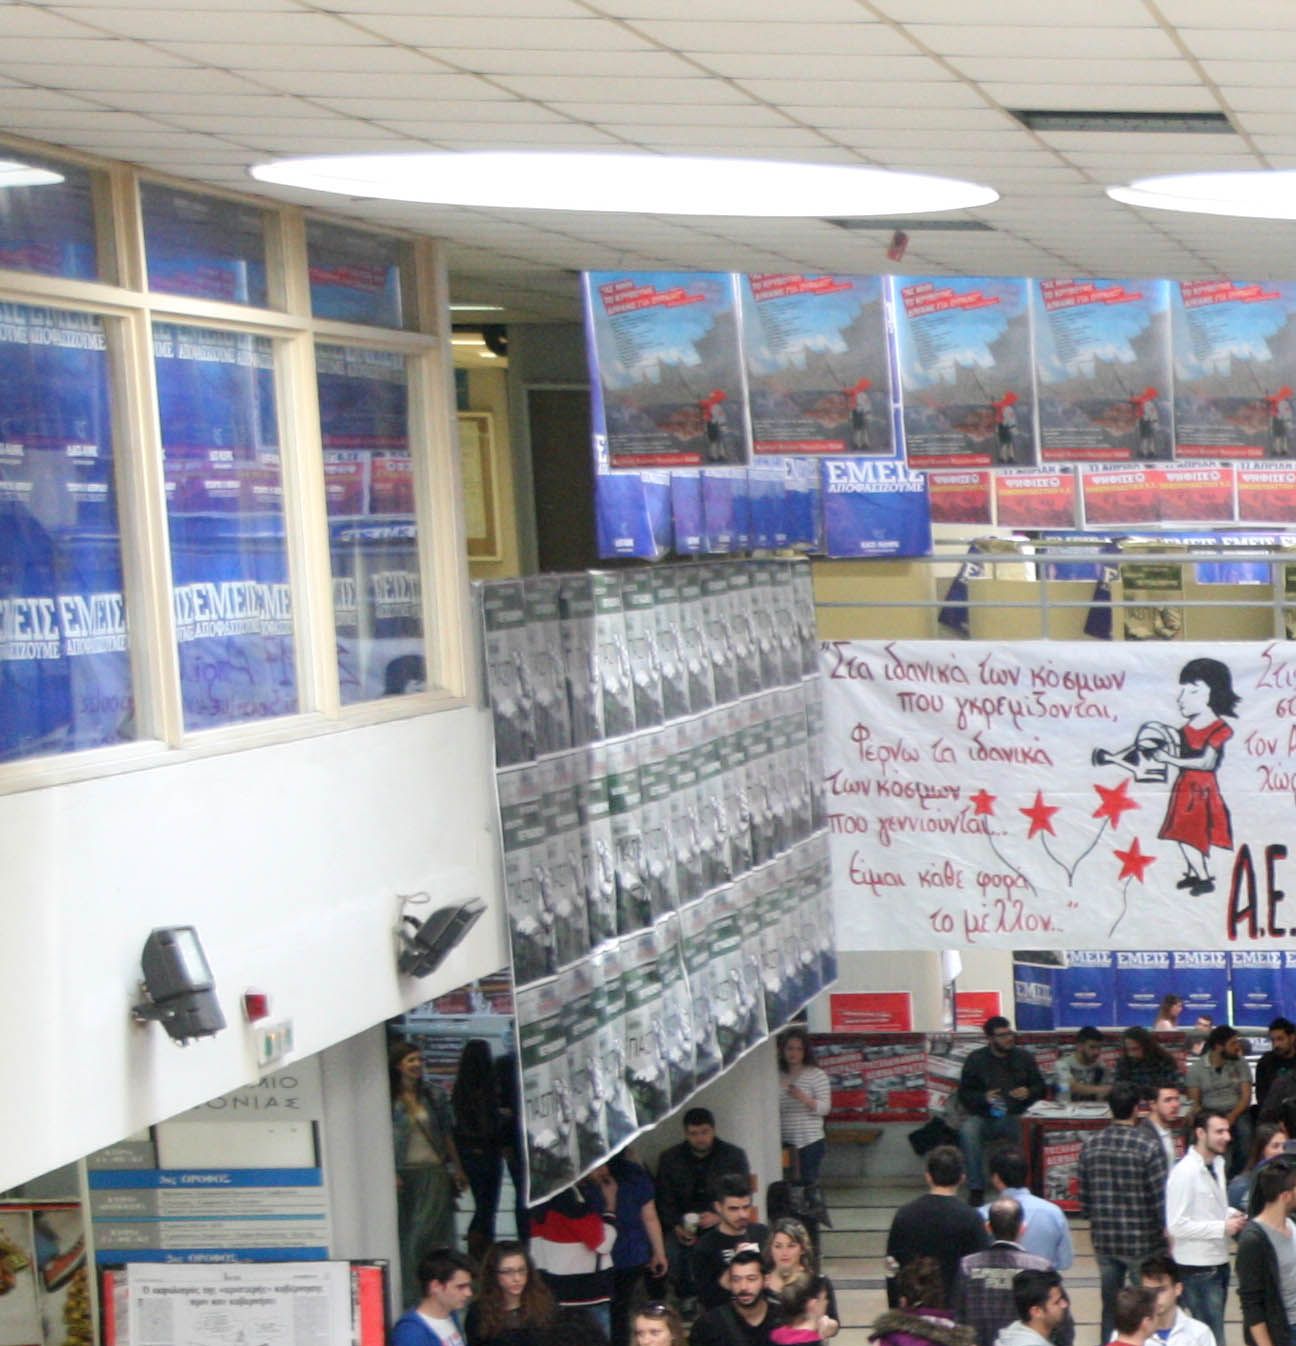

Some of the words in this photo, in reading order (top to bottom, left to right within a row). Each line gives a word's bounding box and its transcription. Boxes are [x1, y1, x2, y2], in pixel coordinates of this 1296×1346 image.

[885, 642, 969, 686] ιδανικά
[978, 652, 1021, 686] των
[1031, 660, 1126, 700] κόσμων
[897, 691, 944, 713] που
[931, 737, 956, 764] τα
[968, 731, 1053, 767] ιδανικά
[1245, 730, 1278, 757] τον
[824, 769, 869, 797] των
[826, 812, 867, 835] που
[918, 860, 964, 889] κάθε
[929, 908, 954, 934] το
[196, 1097, 300, 1110] ΟΝΙΑΣ
